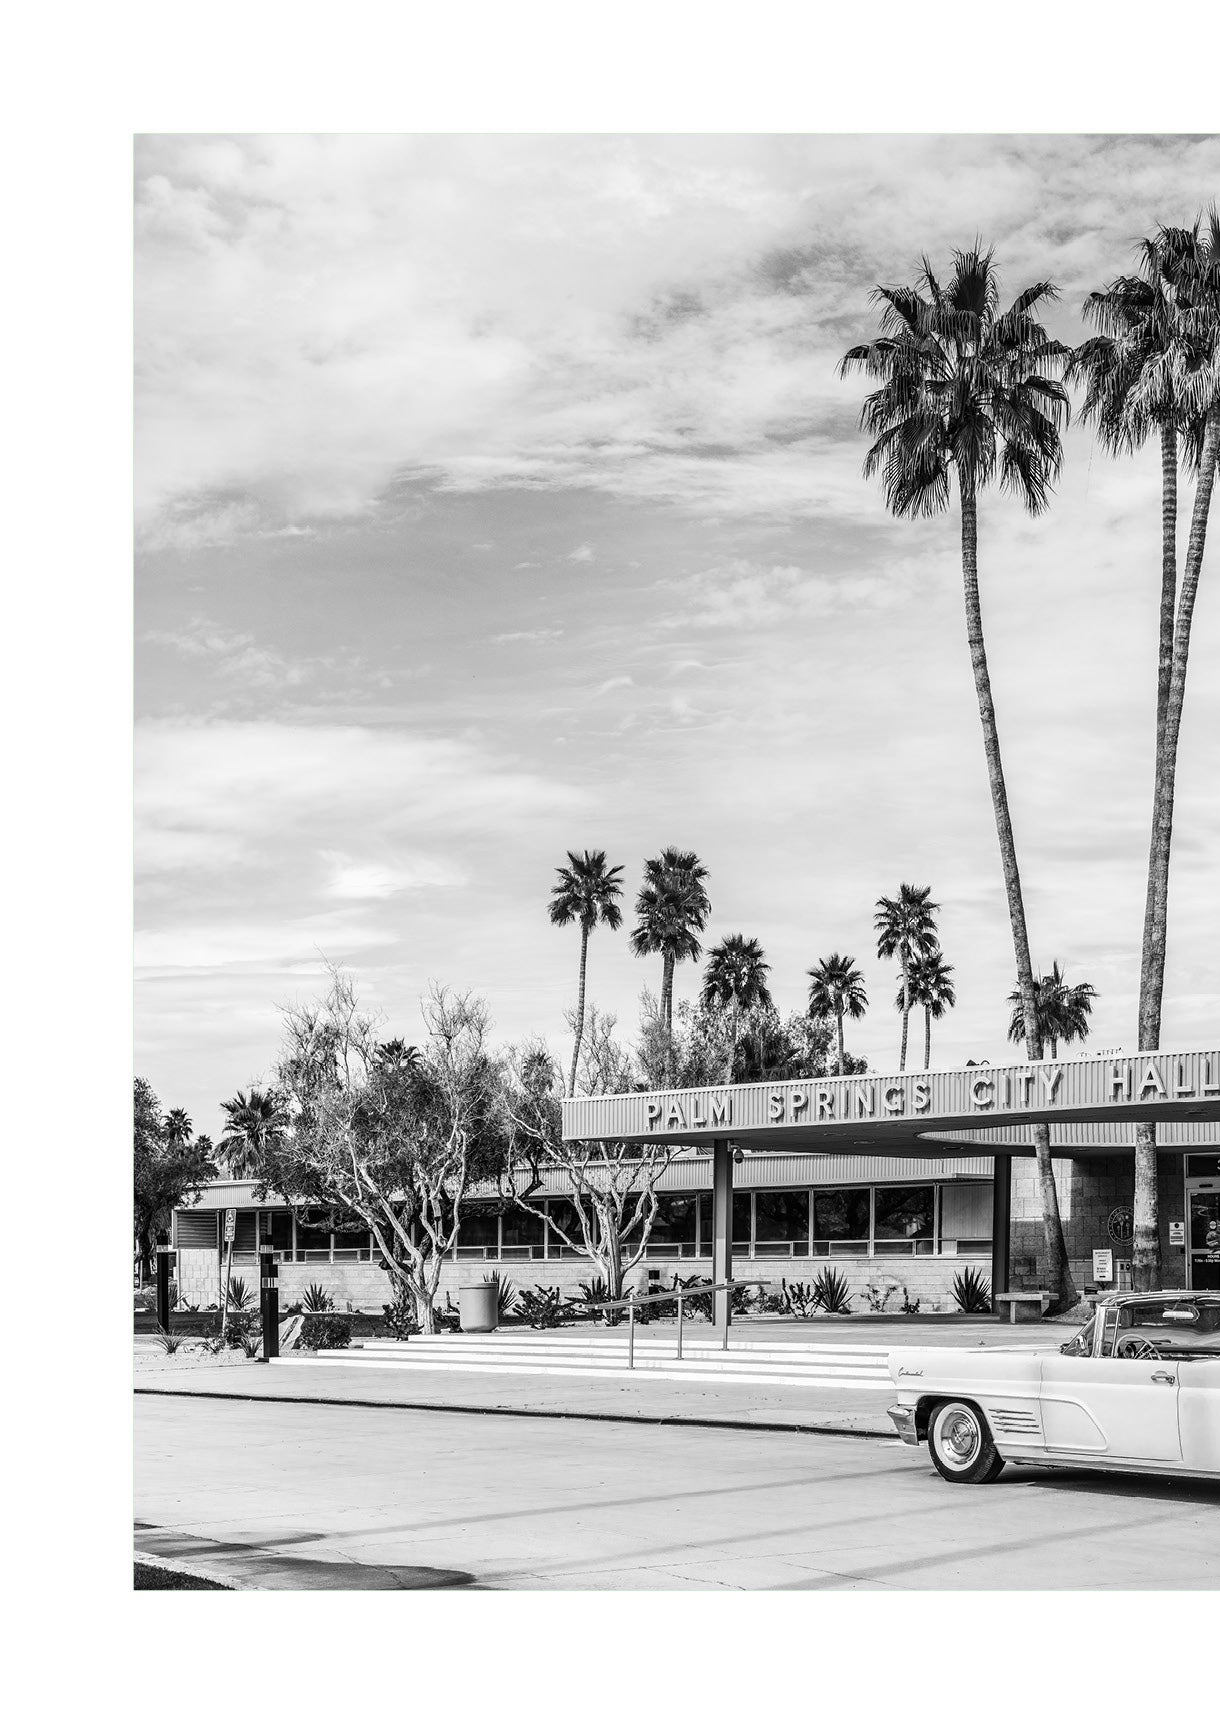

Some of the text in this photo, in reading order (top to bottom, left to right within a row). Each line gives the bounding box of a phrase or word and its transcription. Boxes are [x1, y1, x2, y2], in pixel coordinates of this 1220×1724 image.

[645, 1095, 733, 1127] PALM
[767, 1080, 932, 1120] SPRINGS
[969, 1068, 1063, 1105] CITY
